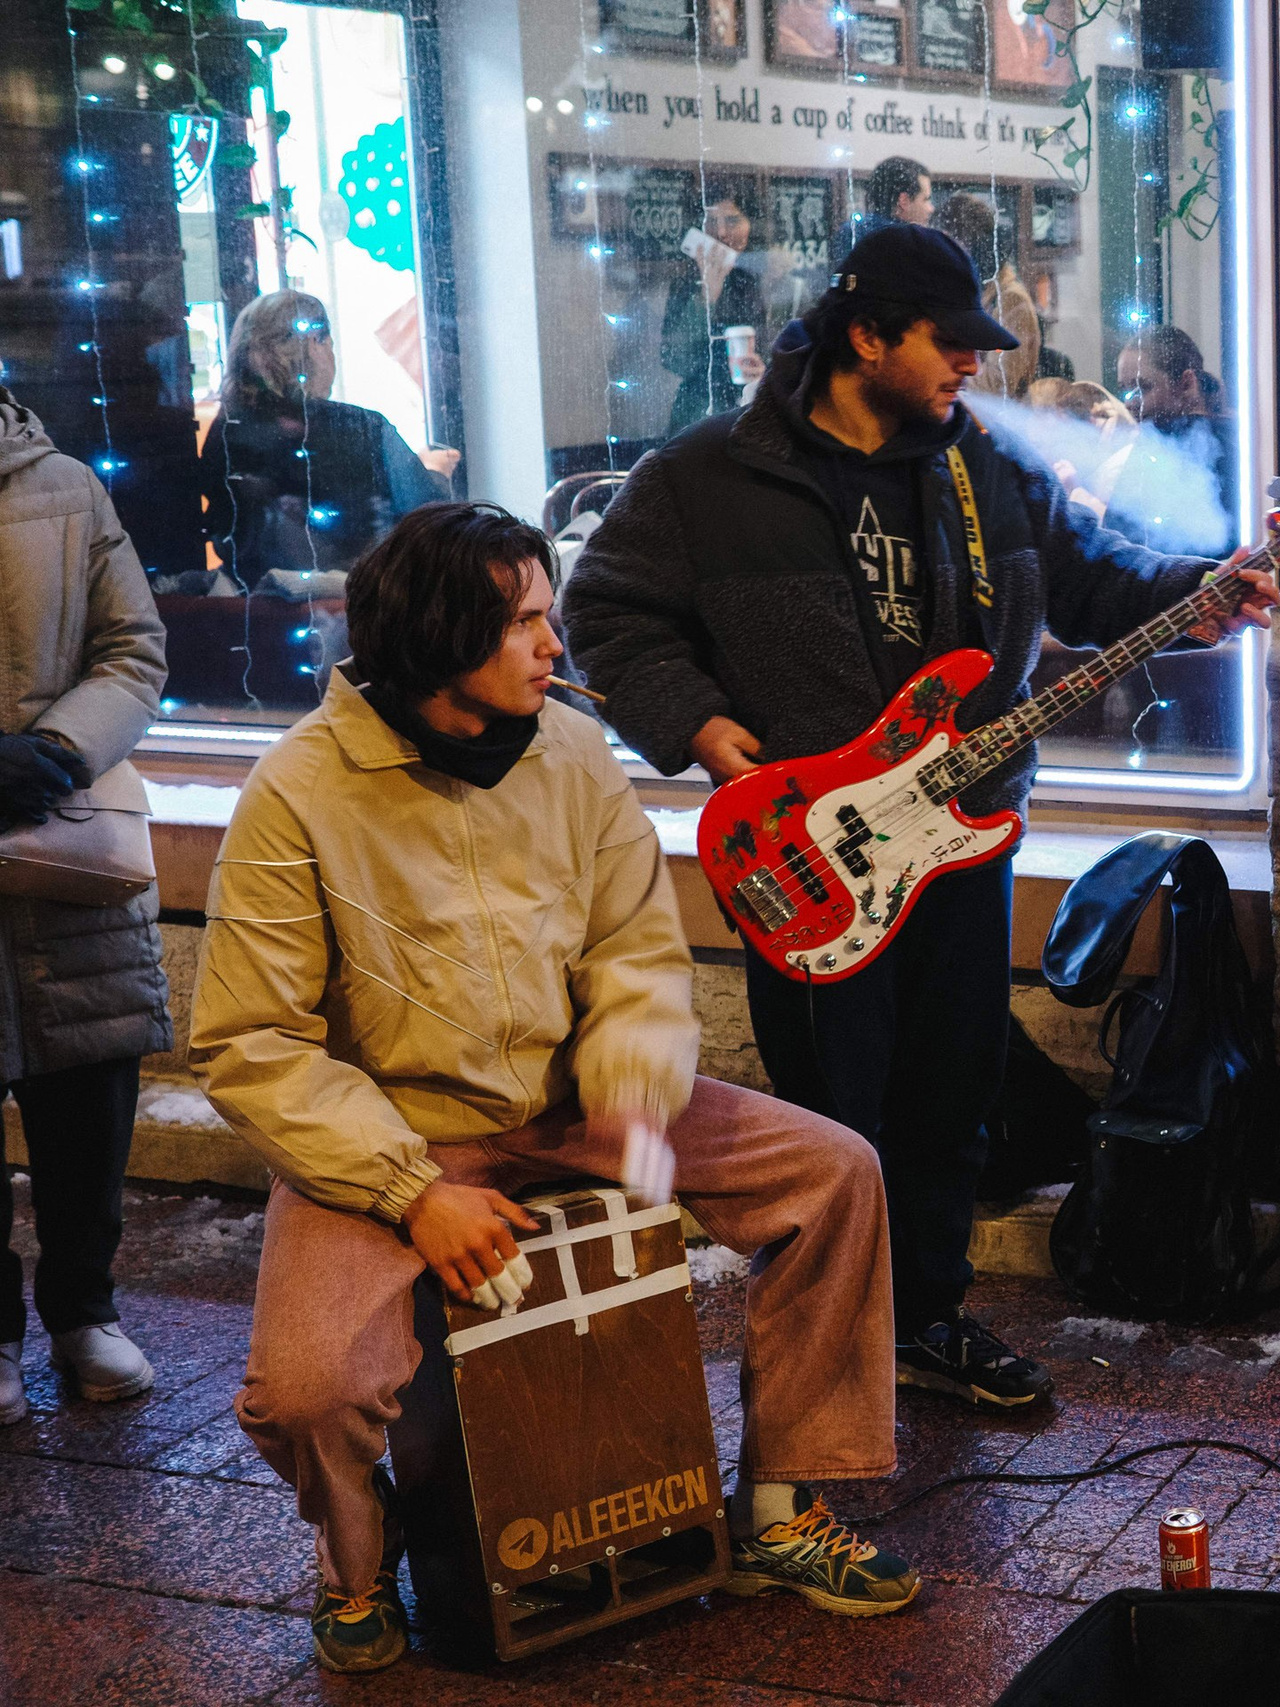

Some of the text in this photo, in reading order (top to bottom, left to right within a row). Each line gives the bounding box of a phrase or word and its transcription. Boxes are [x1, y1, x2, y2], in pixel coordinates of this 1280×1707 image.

[664, 94, 704, 127] you
[715, 84, 761, 124] hold
[771, 104, 782, 124] a
[793, 106, 828, 138] cup
[836, 96, 855, 131] of
[865, 100, 913, 135] coffee
[922, 104, 966, 139] think
[552, 1466, 709, 1554] ALEEEKCN
[1167, 1557, 1197, 1573] ENERGY
